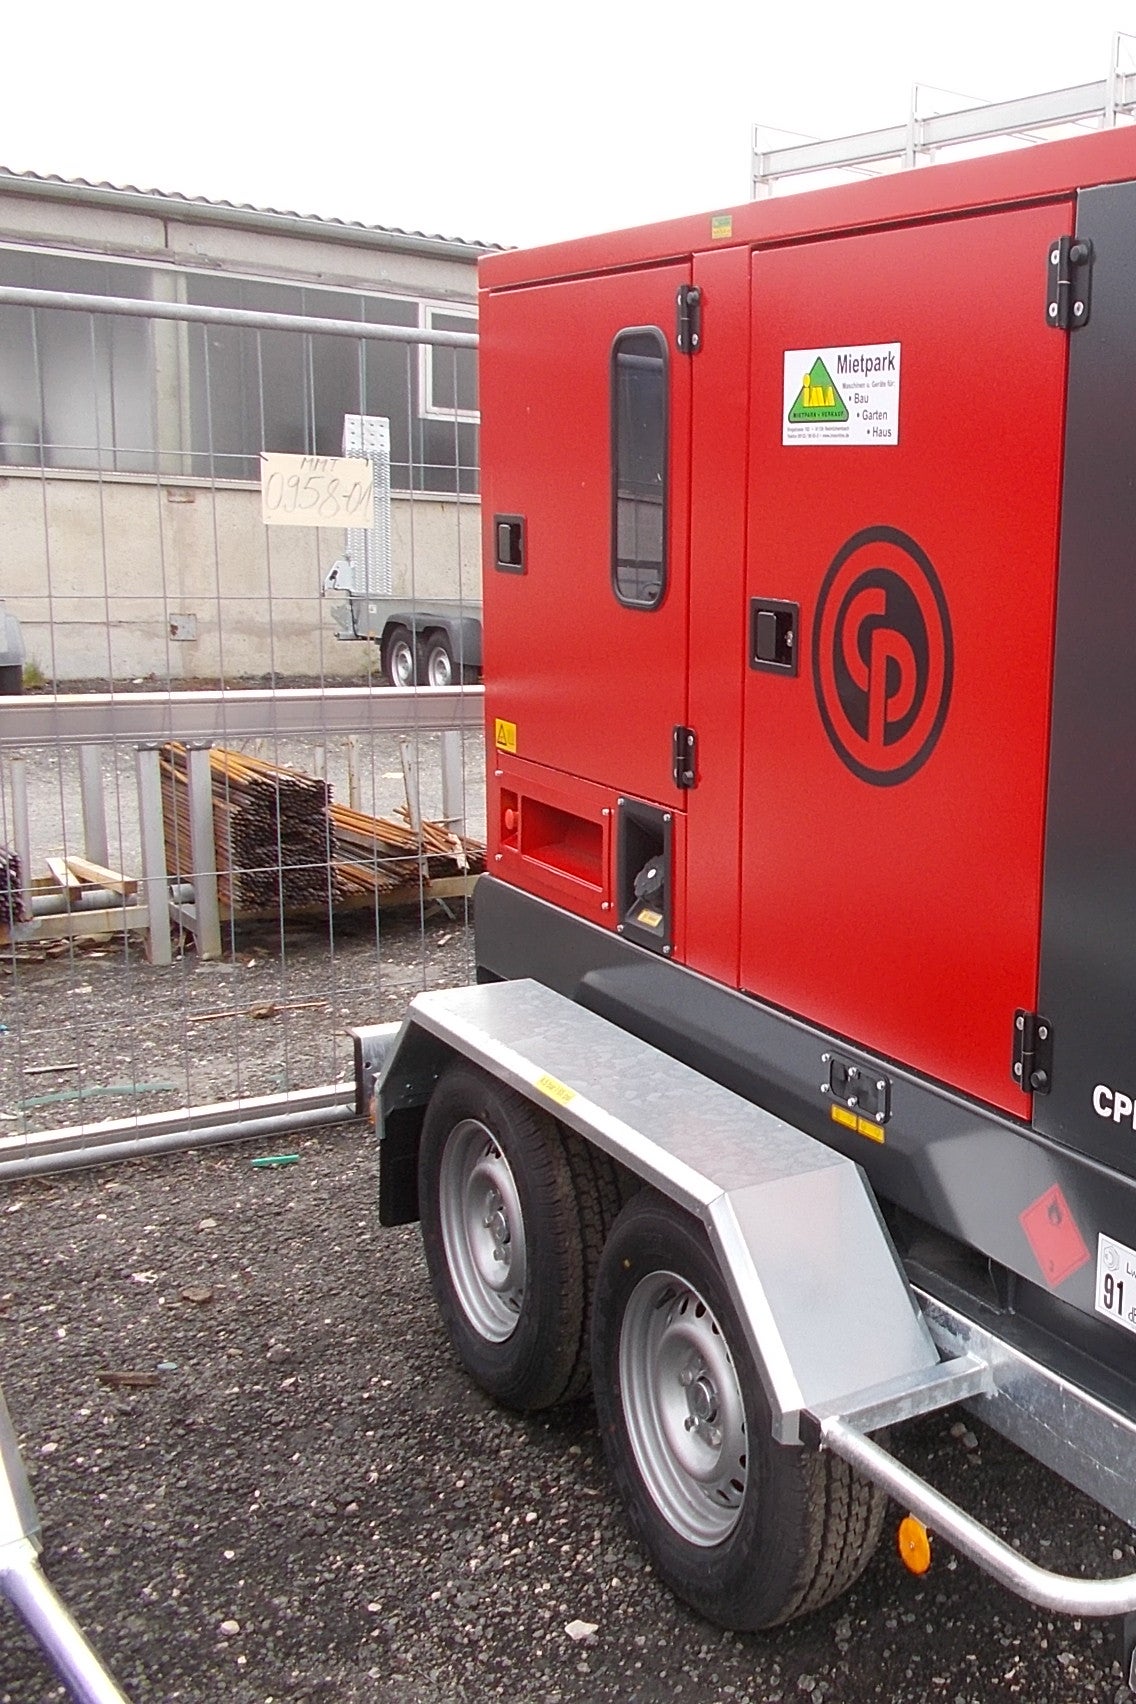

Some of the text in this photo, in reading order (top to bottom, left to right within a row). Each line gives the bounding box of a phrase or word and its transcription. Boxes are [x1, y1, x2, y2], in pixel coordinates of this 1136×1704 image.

[837, 351, 895, 377] Mietpark
[854, 393, 868, 403] Bau
[862, 410, 887, 420] Garten
[873, 427, 892, 437] Haus
[1103, 1273, 1123, 1316] 91
